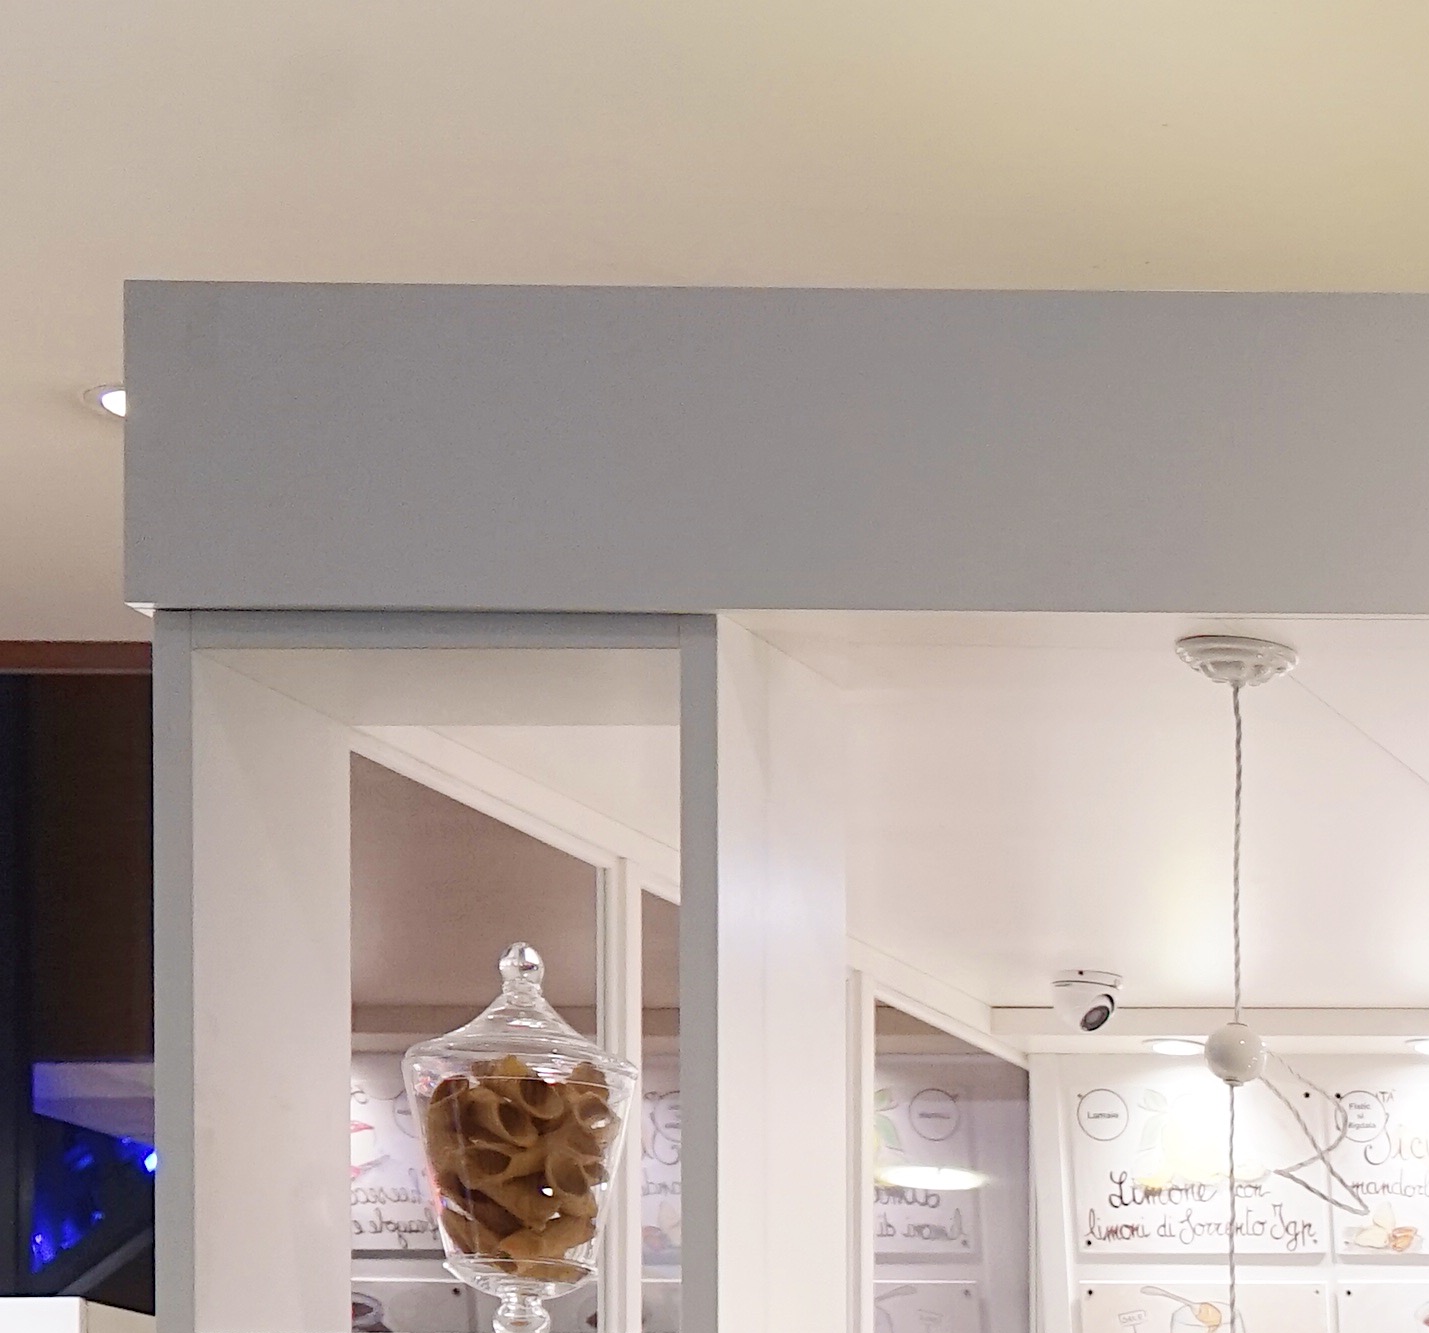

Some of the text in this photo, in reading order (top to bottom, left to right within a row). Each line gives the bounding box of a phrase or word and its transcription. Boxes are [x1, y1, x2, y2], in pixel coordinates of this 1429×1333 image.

[1108, 1171, 1218, 1208] Limone
[1086, 1218, 1150, 1243] limoni
[1157, 1216, 1177, 1239] di
